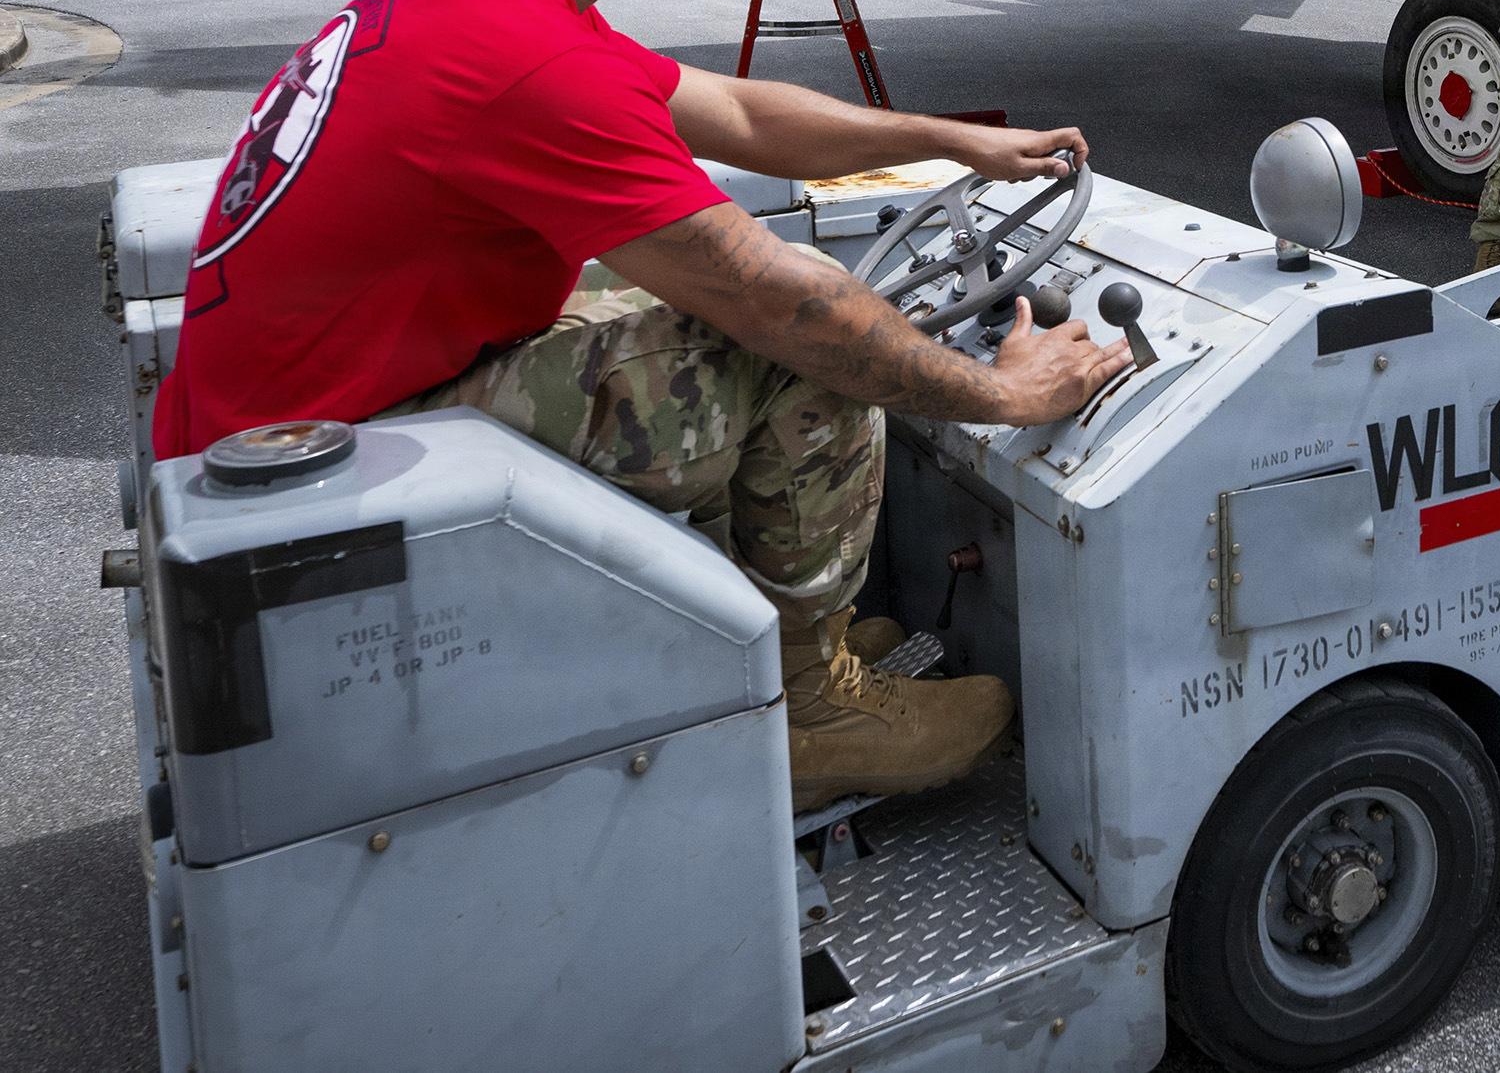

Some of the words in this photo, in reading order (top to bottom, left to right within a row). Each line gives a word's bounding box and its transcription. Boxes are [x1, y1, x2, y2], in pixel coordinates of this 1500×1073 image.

[861, 56, 882, 107] LOUISVILLE
[1251, 449, 1289, 471] HAND
[1294, 438, 1334, 460] PUMP
[336, 622, 402, 651] FUEL
[409, 604, 468, 630] TANK
[1459, 628, 1487, 648] TIRE
[322, 668, 383, 699] JP-4
[393, 656, 423, 678] OR
[435, 638, 492, 668] JP-8
[1469, 647, 1486, 663] 95
[1179, 662, 1245, 718] NSN
